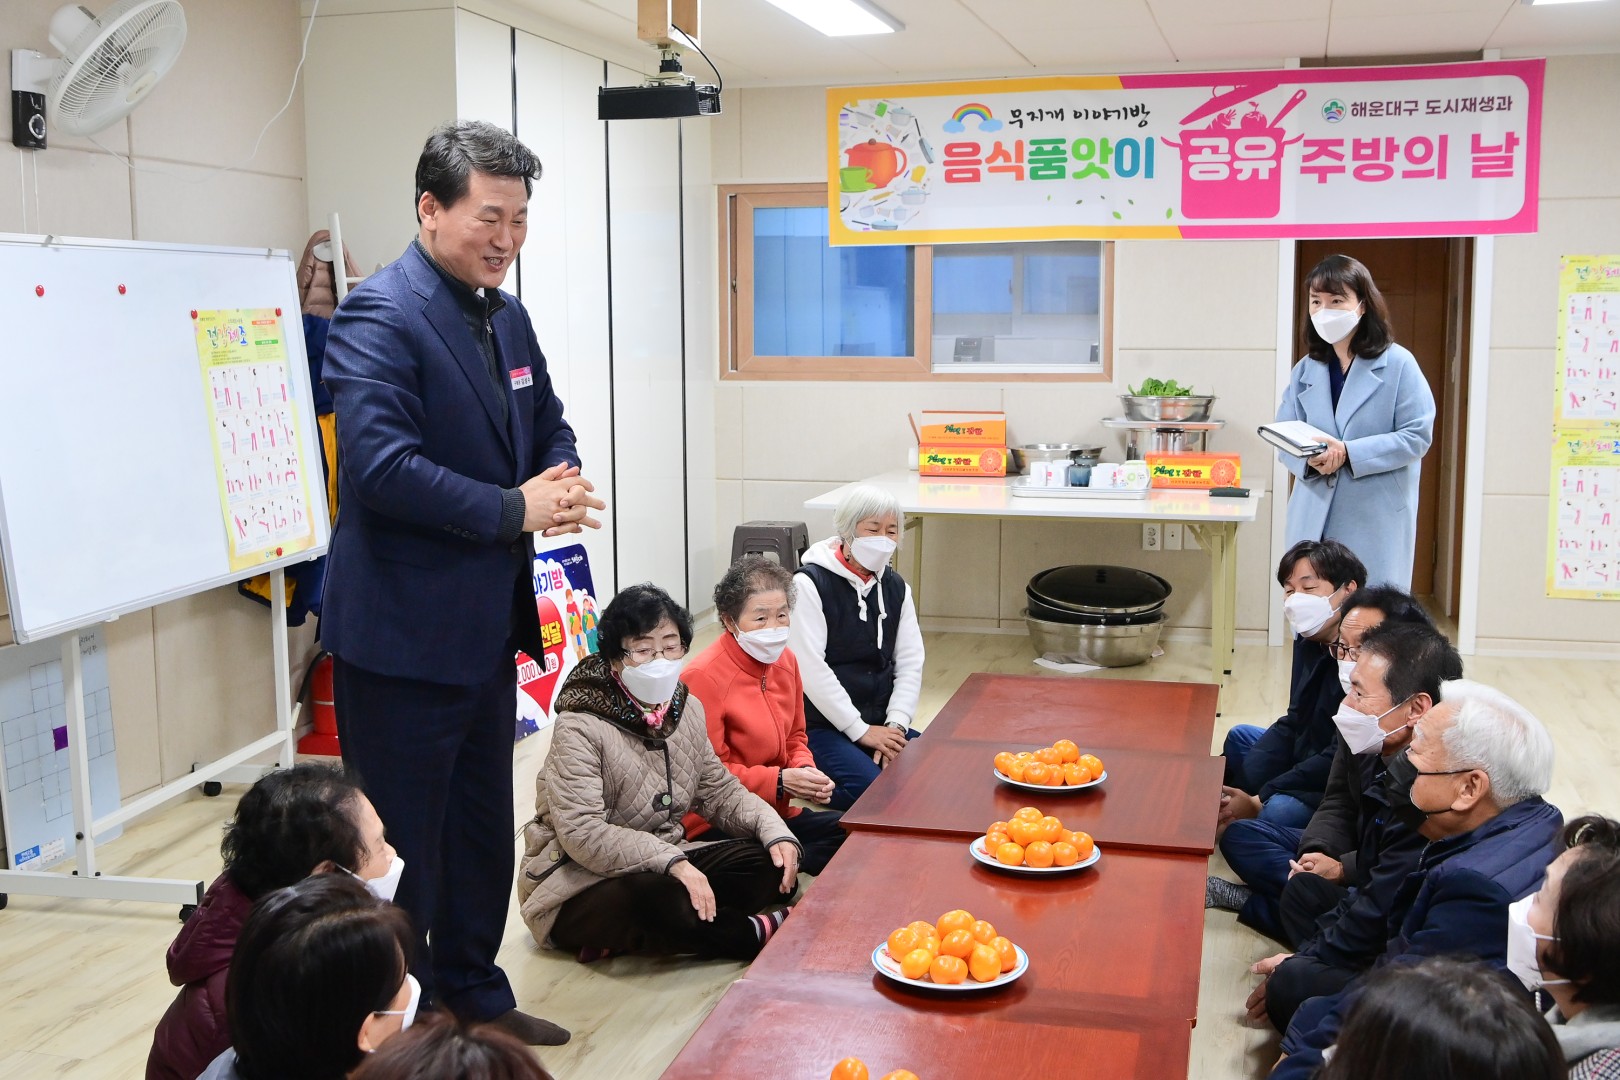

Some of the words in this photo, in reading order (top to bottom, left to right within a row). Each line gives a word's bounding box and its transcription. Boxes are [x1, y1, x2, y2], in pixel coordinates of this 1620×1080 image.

[1008, 106, 1065, 129] 무지개
[1072, 103, 1151, 128] 이야기방
[1350, 98, 1419, 119] 해운대구
[1425, 95, 1514, 115] 도시재생과
[943, 137, 1154, 183] 음식품앗이
[1188, 136, 1277, 181] 공유
[1299, 134, 1447, 184] 주방의
[1470, 131, 1520, 179] 날
